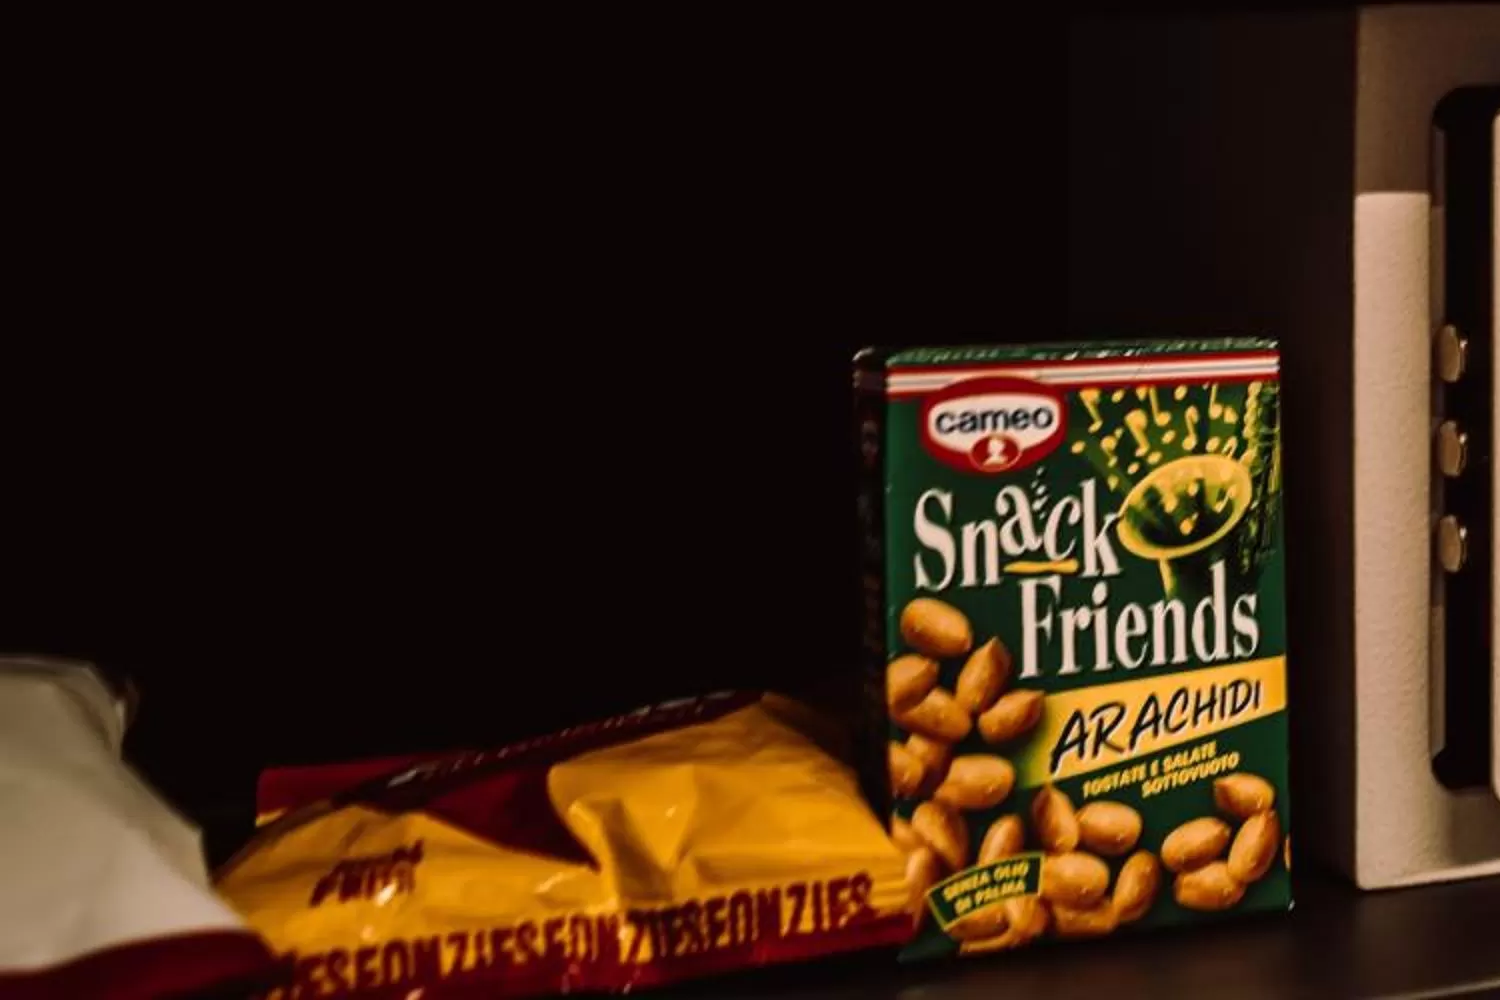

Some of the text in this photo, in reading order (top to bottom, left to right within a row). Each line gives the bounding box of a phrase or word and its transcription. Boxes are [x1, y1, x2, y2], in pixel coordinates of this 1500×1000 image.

[935, 407, 1054, 435] cameo
[913, 478, 1121, 591] Snack
[1018, 561, 1259, 679] Friends
[1049, 678, 1261, 775] ARACHIDI
[1082, 763, 1147, 799] TOSTATE
[1163, 740, 1218, 772] SALATE
[1141, 751, 1241, 799] SOTTOVUOTO
